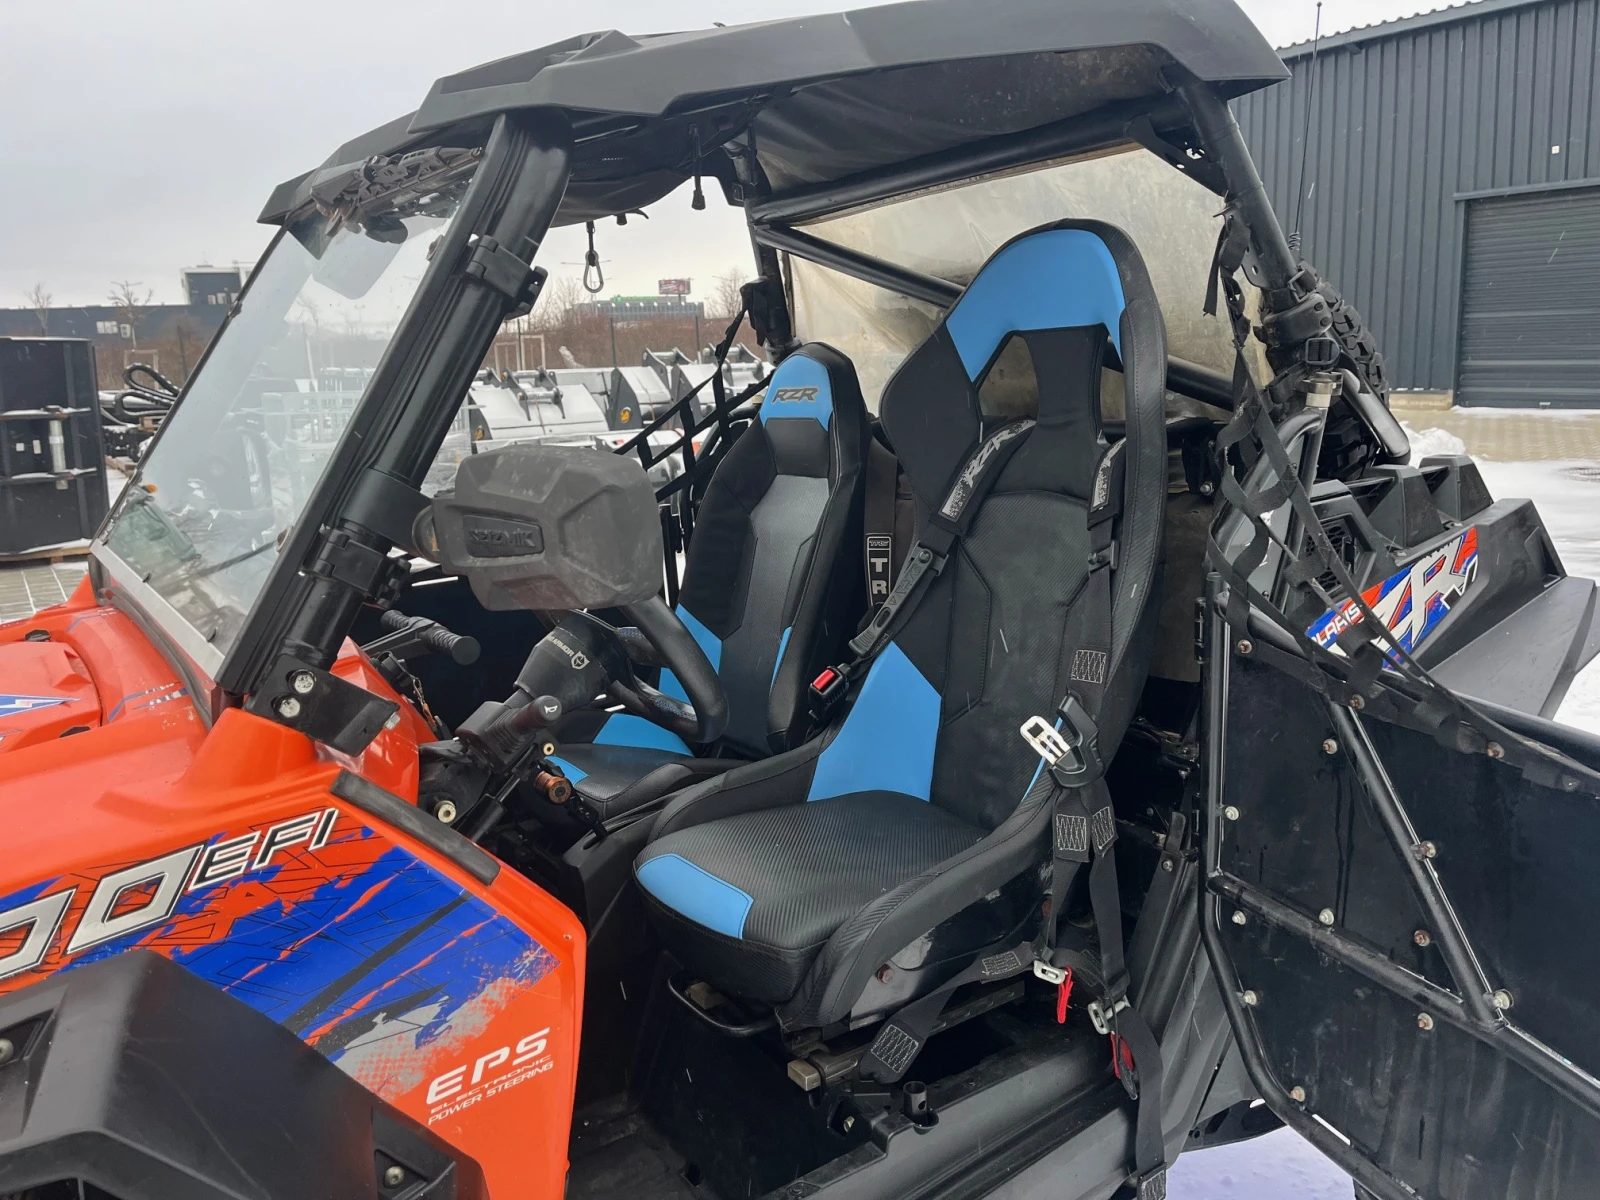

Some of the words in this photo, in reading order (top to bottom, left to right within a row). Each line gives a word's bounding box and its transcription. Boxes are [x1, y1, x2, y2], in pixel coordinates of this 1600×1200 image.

[771, 386, 820, 405] RZR
[188, 807, 339, 890] EFI
[426, 1027, 551, 1105] EPS
[428, 1093, 482, 1126] POWER
[486, 1060, 554, 1098] STEERING
[430, 1054, 552, 1114] ELECTRONIC
